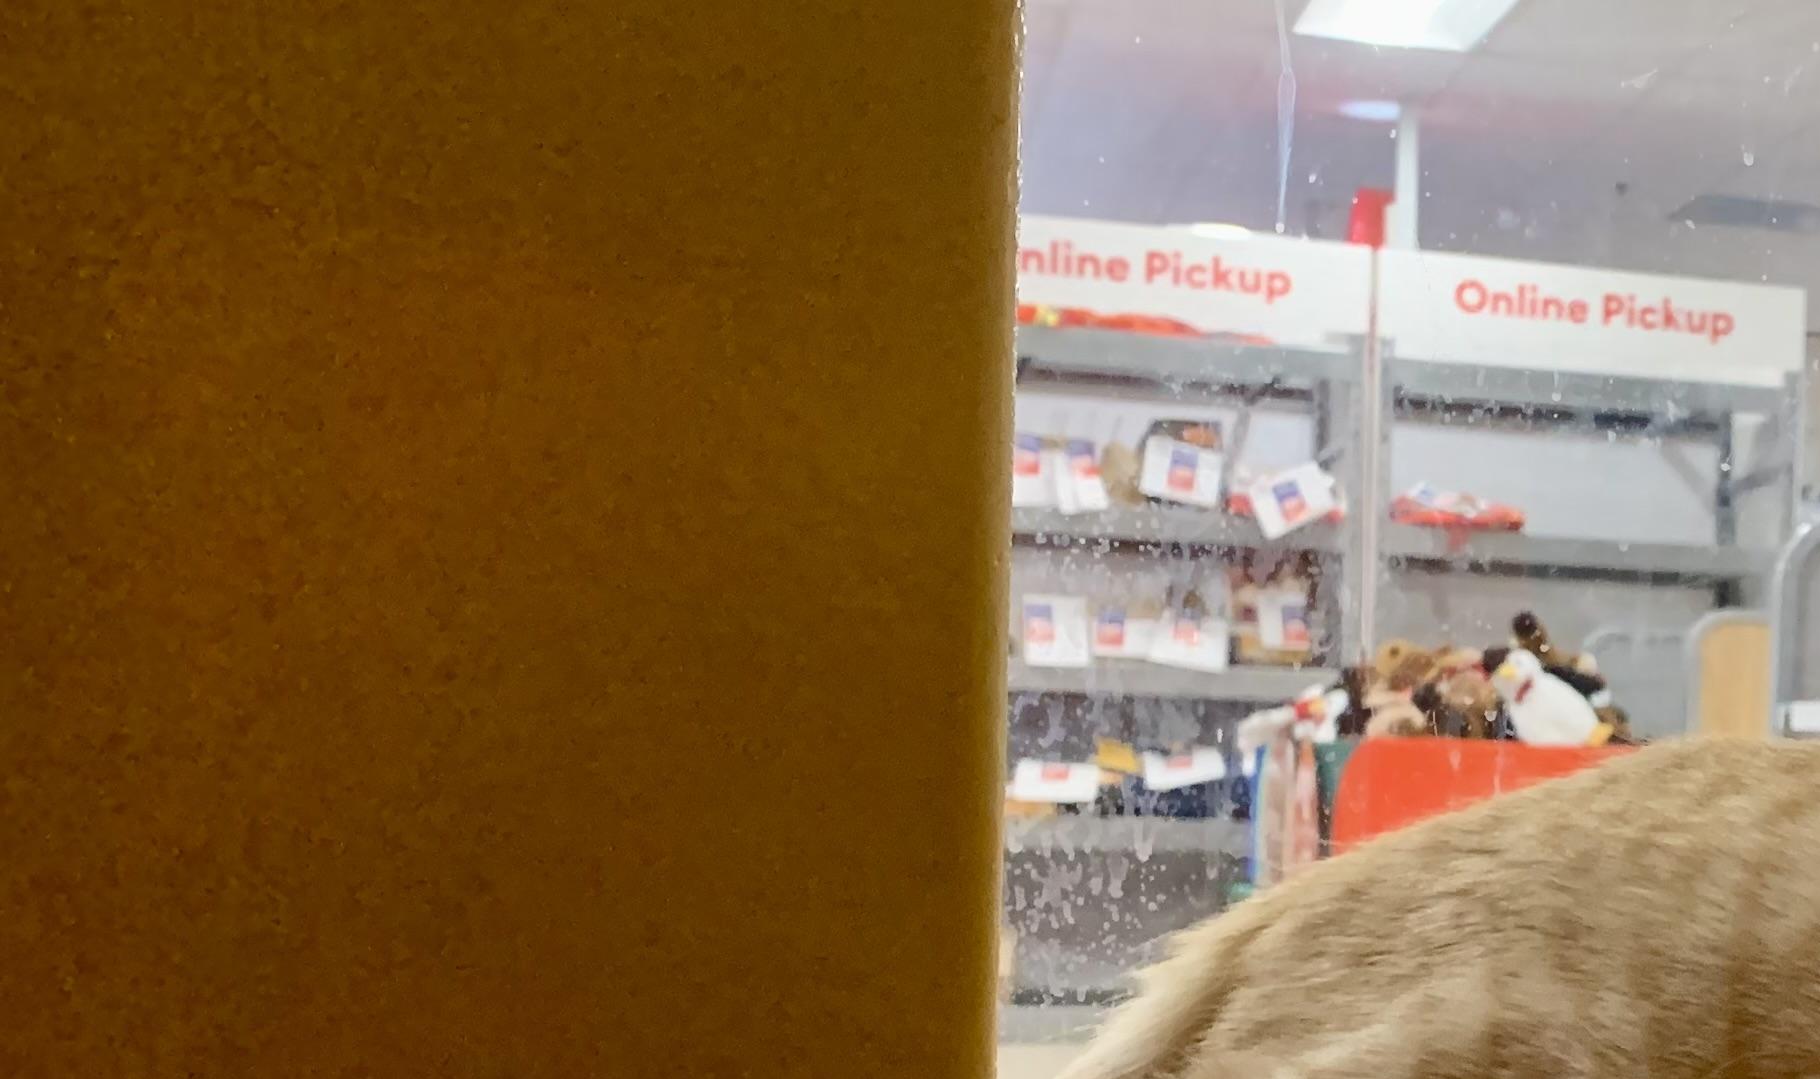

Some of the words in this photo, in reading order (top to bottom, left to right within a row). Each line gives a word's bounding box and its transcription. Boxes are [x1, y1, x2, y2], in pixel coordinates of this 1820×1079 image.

[1020, 240, 1131, 284] nline
[1144, 248, 1293, 304] Pickup
[1454, 279, 1589, 325] Online
[1602, 293, 1735, 345] Pickup
